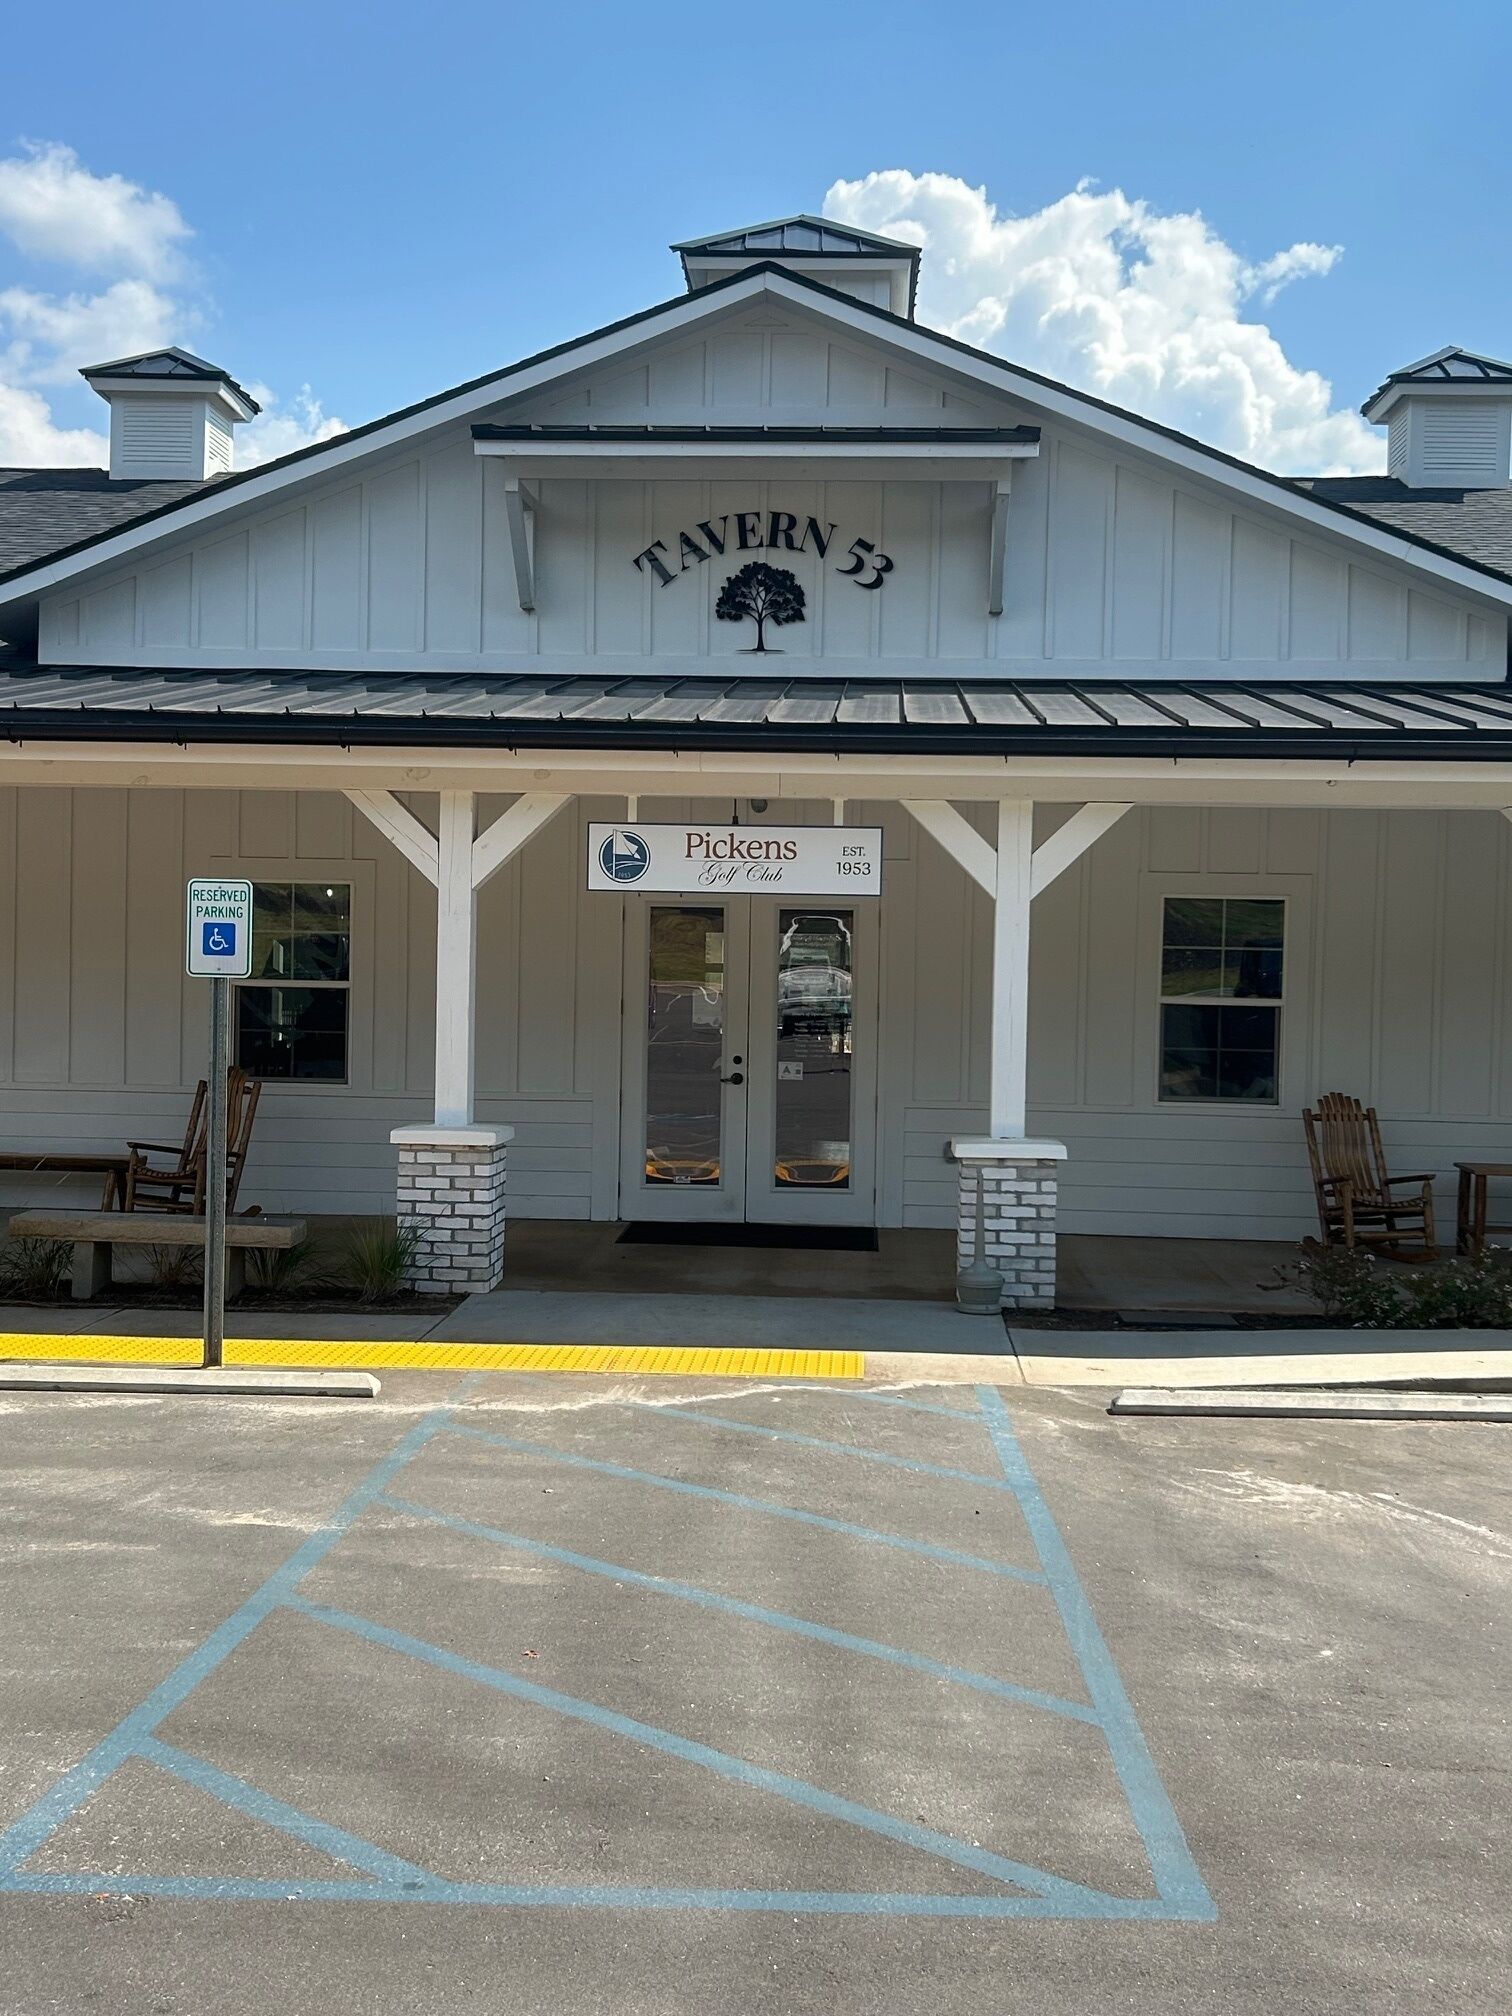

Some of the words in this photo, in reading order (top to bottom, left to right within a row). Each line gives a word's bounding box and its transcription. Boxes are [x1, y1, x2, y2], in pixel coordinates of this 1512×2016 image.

[633, 511, 838, 588] TAVERN
[835, 537, 894, 590] 53
[685, 832, 797, 860] Pickens
[842, 846, 866, 857] EST.
[698, 860, 741, 888] Golf
[742, 861, 783, 882] Club
[836, 861, 871, 876] 1953
[193, 889, 246, 902] RESERVED
[196, 906, 243, 918] PARKING
